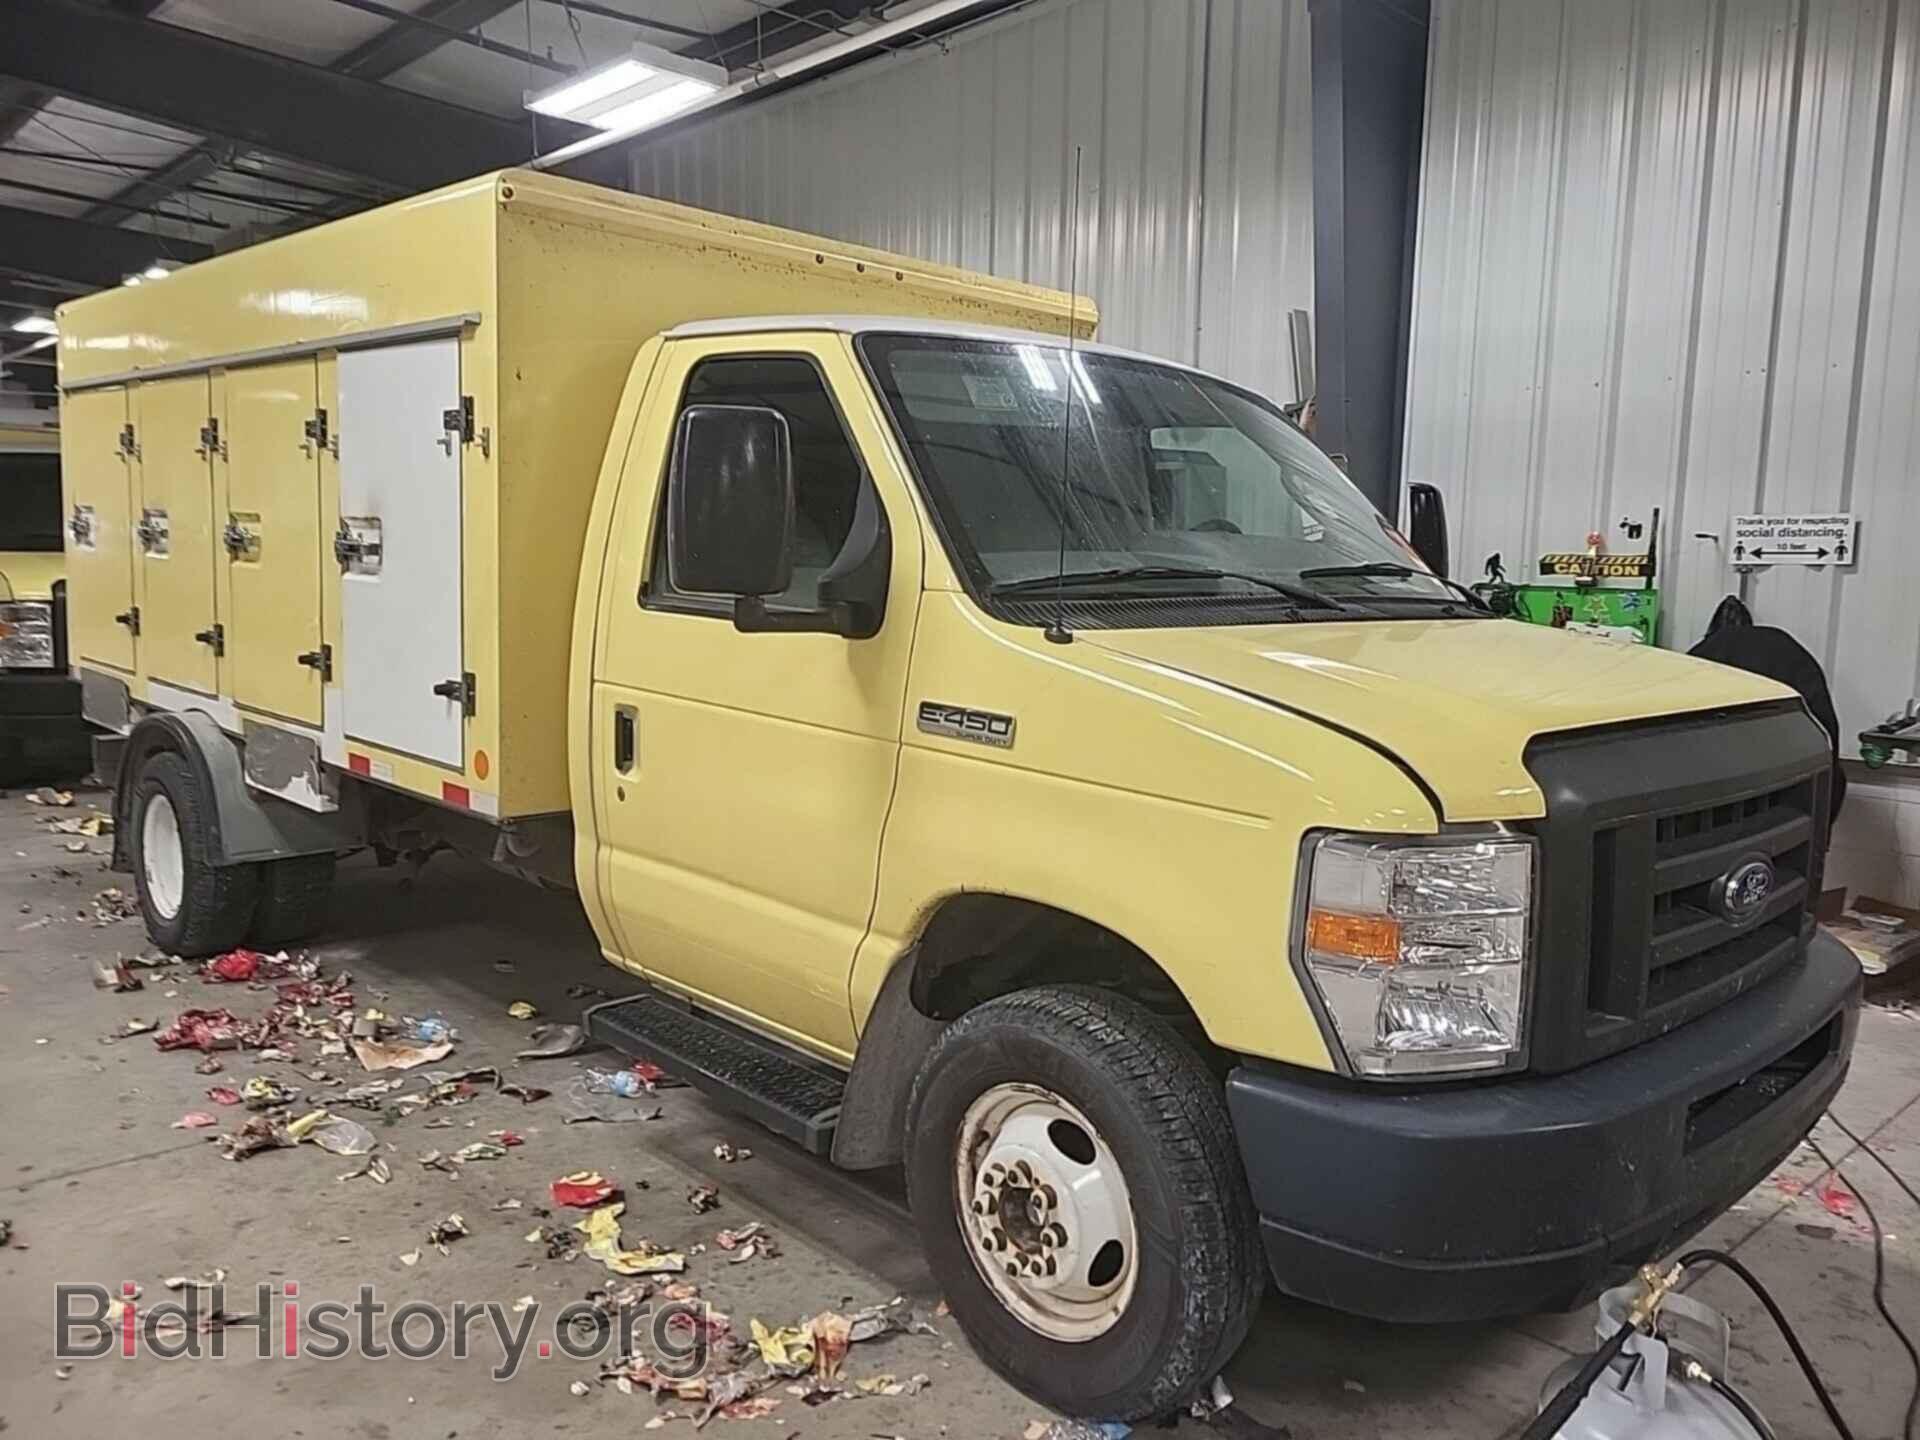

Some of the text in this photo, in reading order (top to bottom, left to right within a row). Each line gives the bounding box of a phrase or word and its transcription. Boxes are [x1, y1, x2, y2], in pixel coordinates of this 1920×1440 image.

[1767, 518, 1785, 526] you
[1786, 517, 1798, 525] for
[1801, 516, 1849, 526] respecting
[1736, 527, 1848, 539] social distancing.
[1553, 562, 1640, 576] CAION
